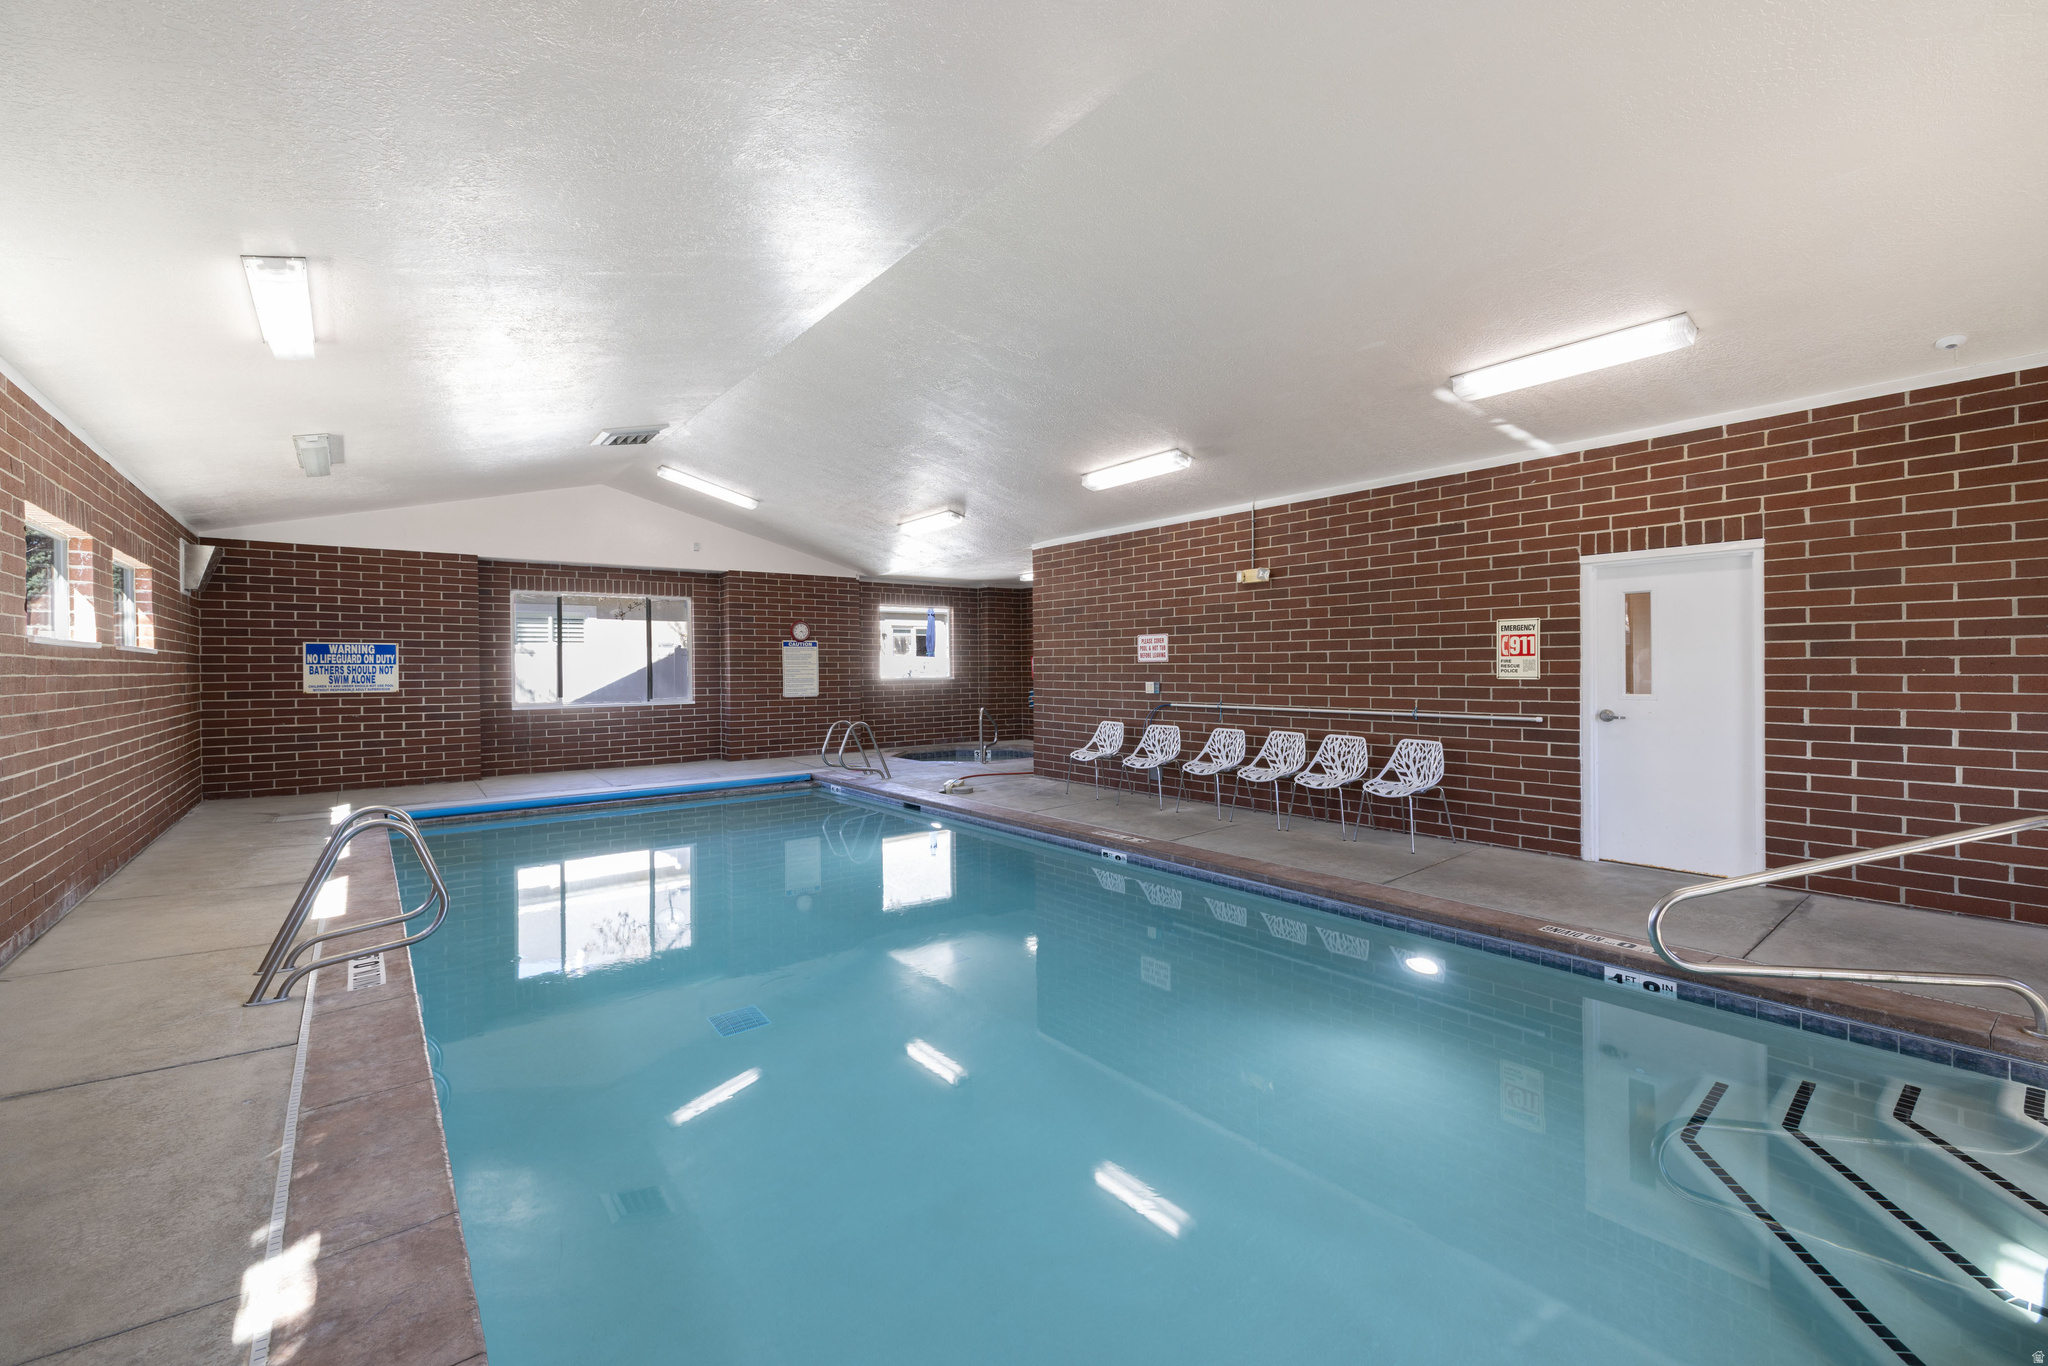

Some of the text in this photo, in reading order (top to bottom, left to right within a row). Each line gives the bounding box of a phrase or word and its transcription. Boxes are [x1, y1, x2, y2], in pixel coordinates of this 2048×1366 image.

[329, 644, 375, 654] WARNING
[1510, 636, 1535, 654] 911
[307, 654, 395, 664] NO LIFEGUARD ON DUTY
[309, 666, 394, 675] BATHERS SHOULD NOT
[329, 675, 376, 684] SWIM ALONE
[1542, 926, 1583, 938] DIVING
[1643, 981, 1660, 992] 0
[1662, 984, 1673, 992] IN
